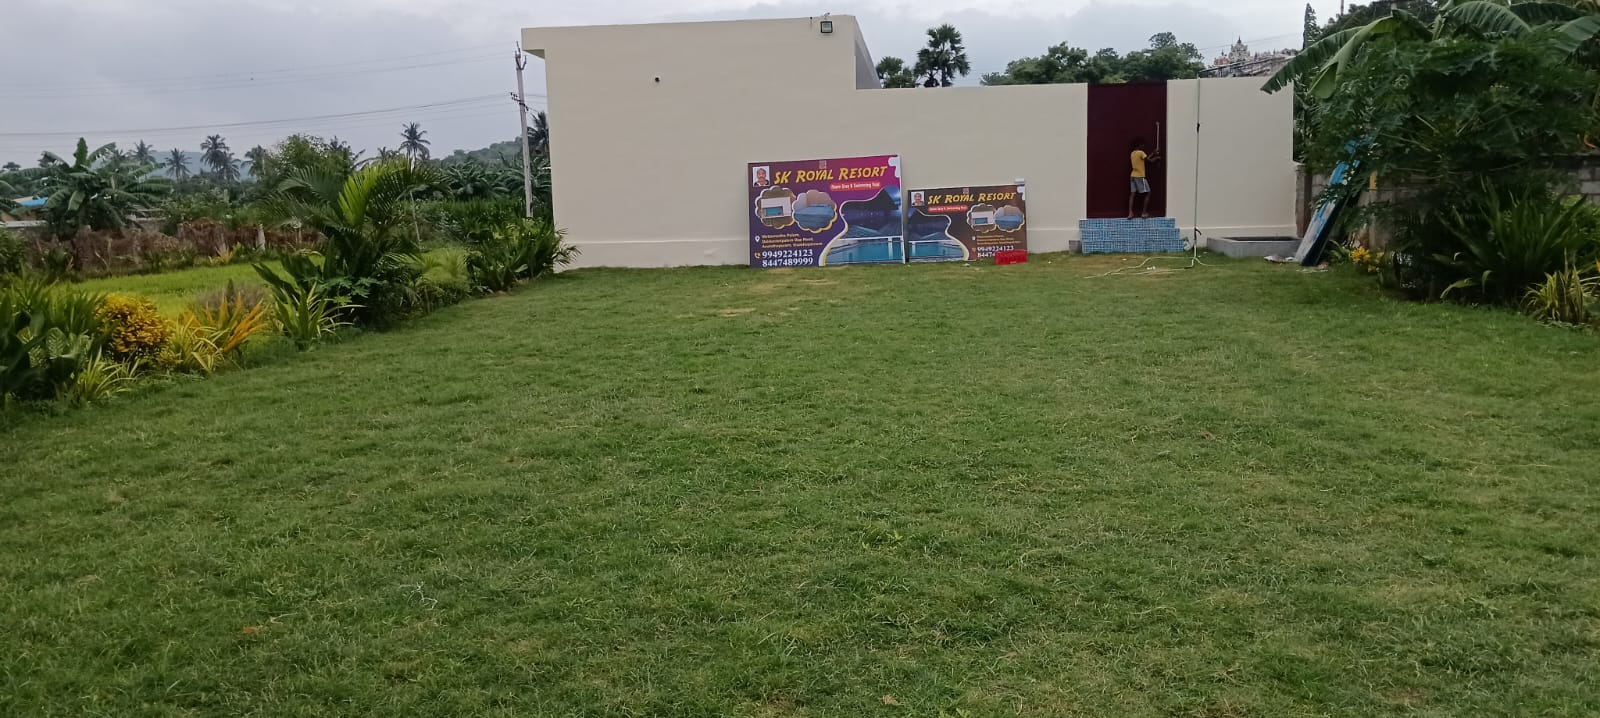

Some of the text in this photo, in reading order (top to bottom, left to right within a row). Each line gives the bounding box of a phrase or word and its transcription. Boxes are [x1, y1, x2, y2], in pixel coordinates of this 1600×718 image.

[774, 165, 888, 184] SK ROYAL RESORT
[927, 191, 1017, 205] SK ROYAL RESORT
[762, 249, 813, 259] 9949224123
[762, 257, 813, 268] 8447489999
